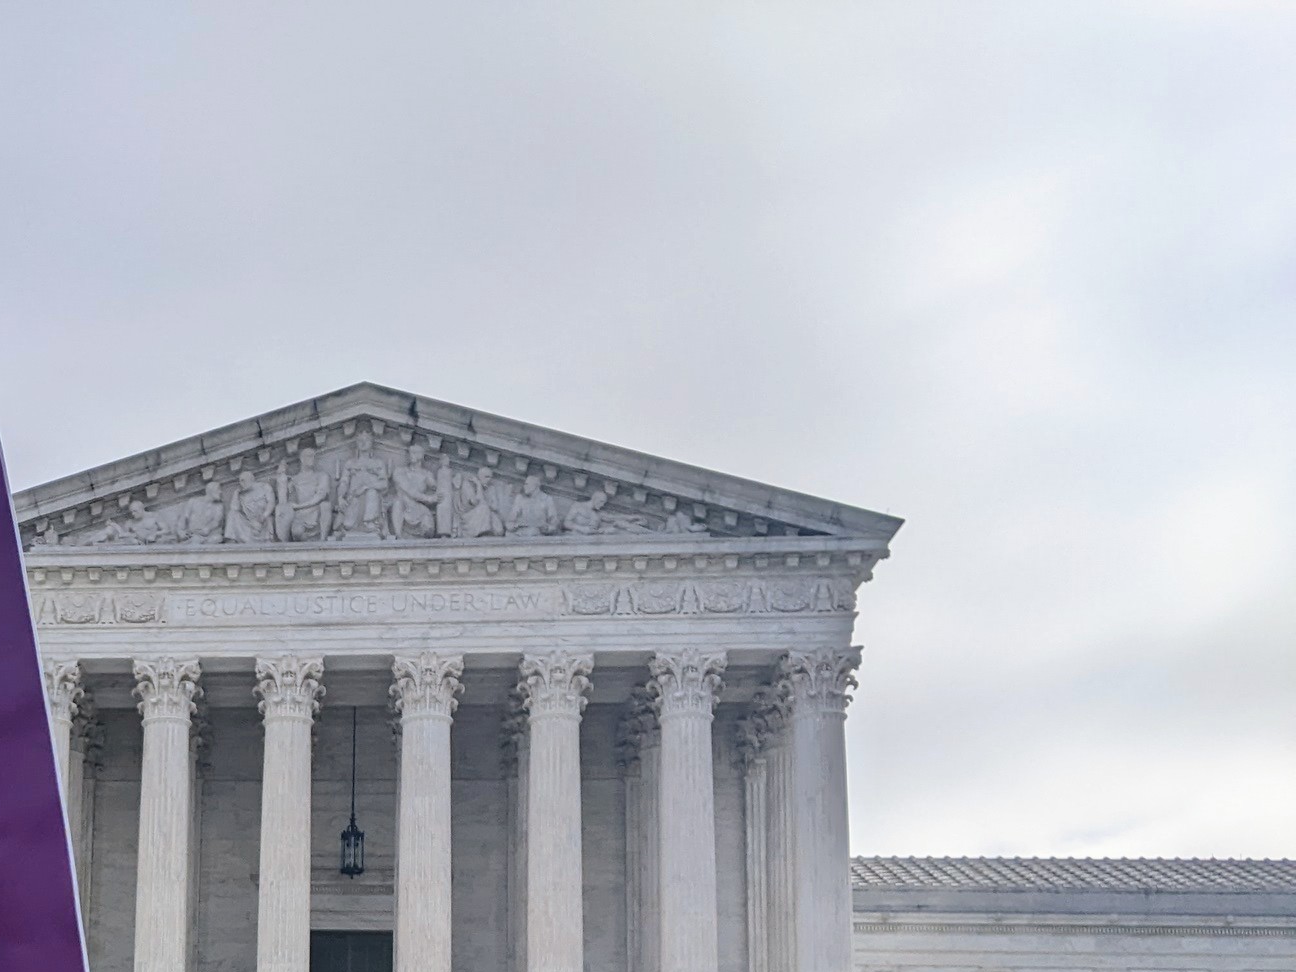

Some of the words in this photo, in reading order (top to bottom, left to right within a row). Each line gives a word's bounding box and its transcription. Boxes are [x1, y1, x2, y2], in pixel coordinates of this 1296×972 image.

[185, 598, 270, 617] EQUAL
[276, 595, 377, 616] JUSTICE
[391, 593, 480, 613] UNDER
[490, 592, 541, 611] LAW
